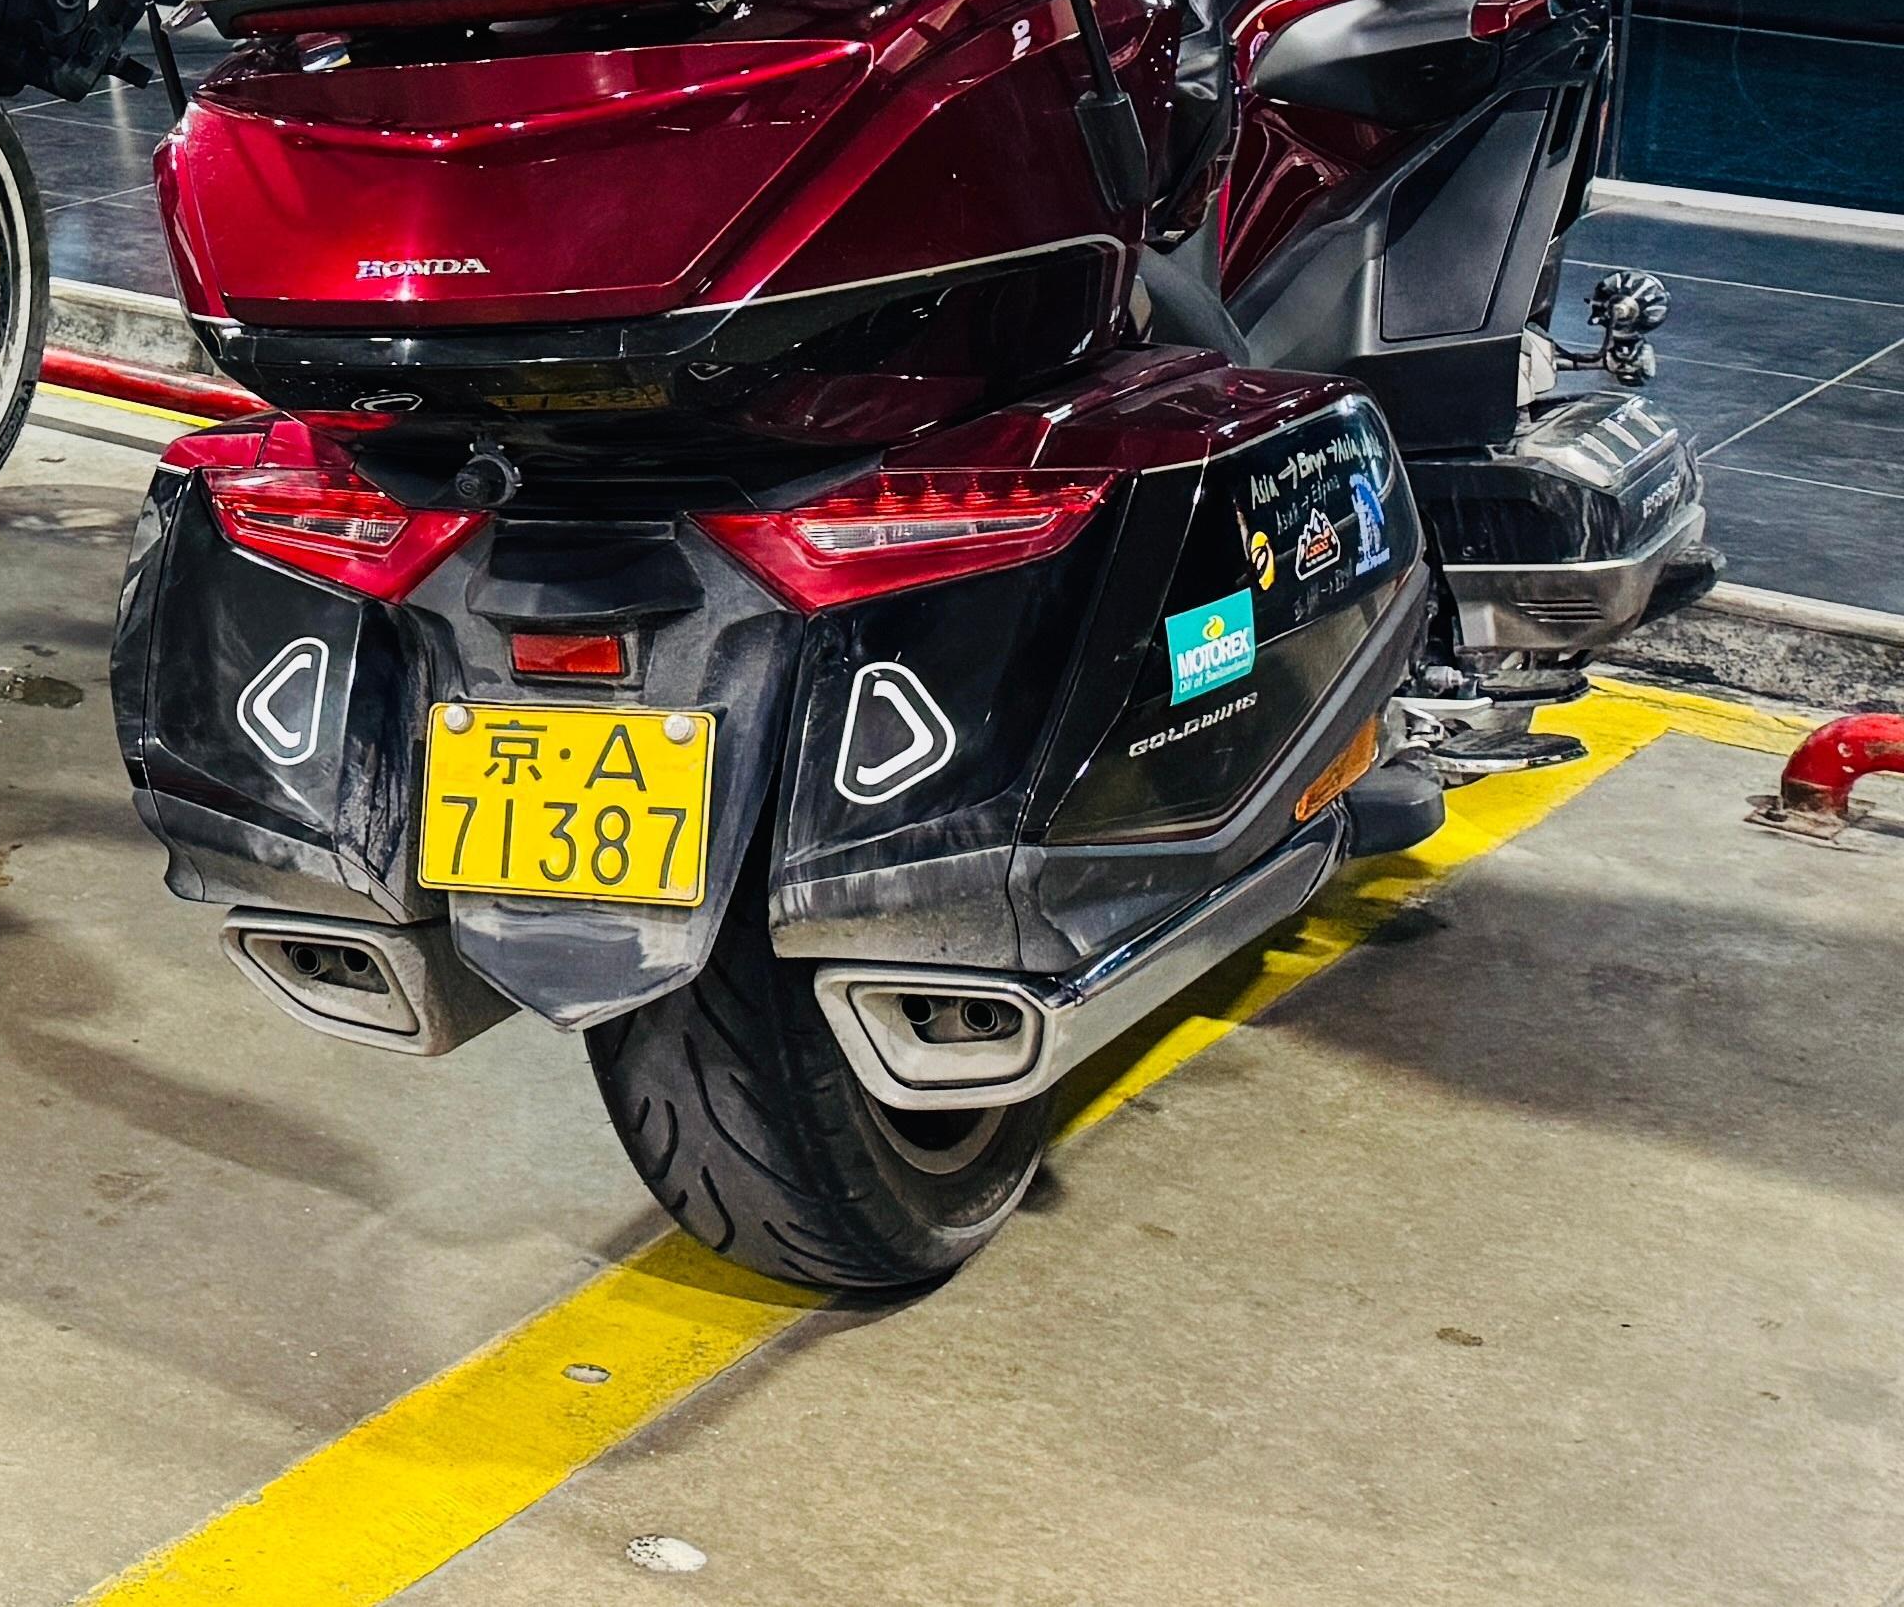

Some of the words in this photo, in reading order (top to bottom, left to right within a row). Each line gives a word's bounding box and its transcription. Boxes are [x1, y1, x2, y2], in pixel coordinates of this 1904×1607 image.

[355, 258, 491, 280] HONDA
[1176, 627, 1251, 680] MOTOREX
[441, 795, 687, 890] 71387
